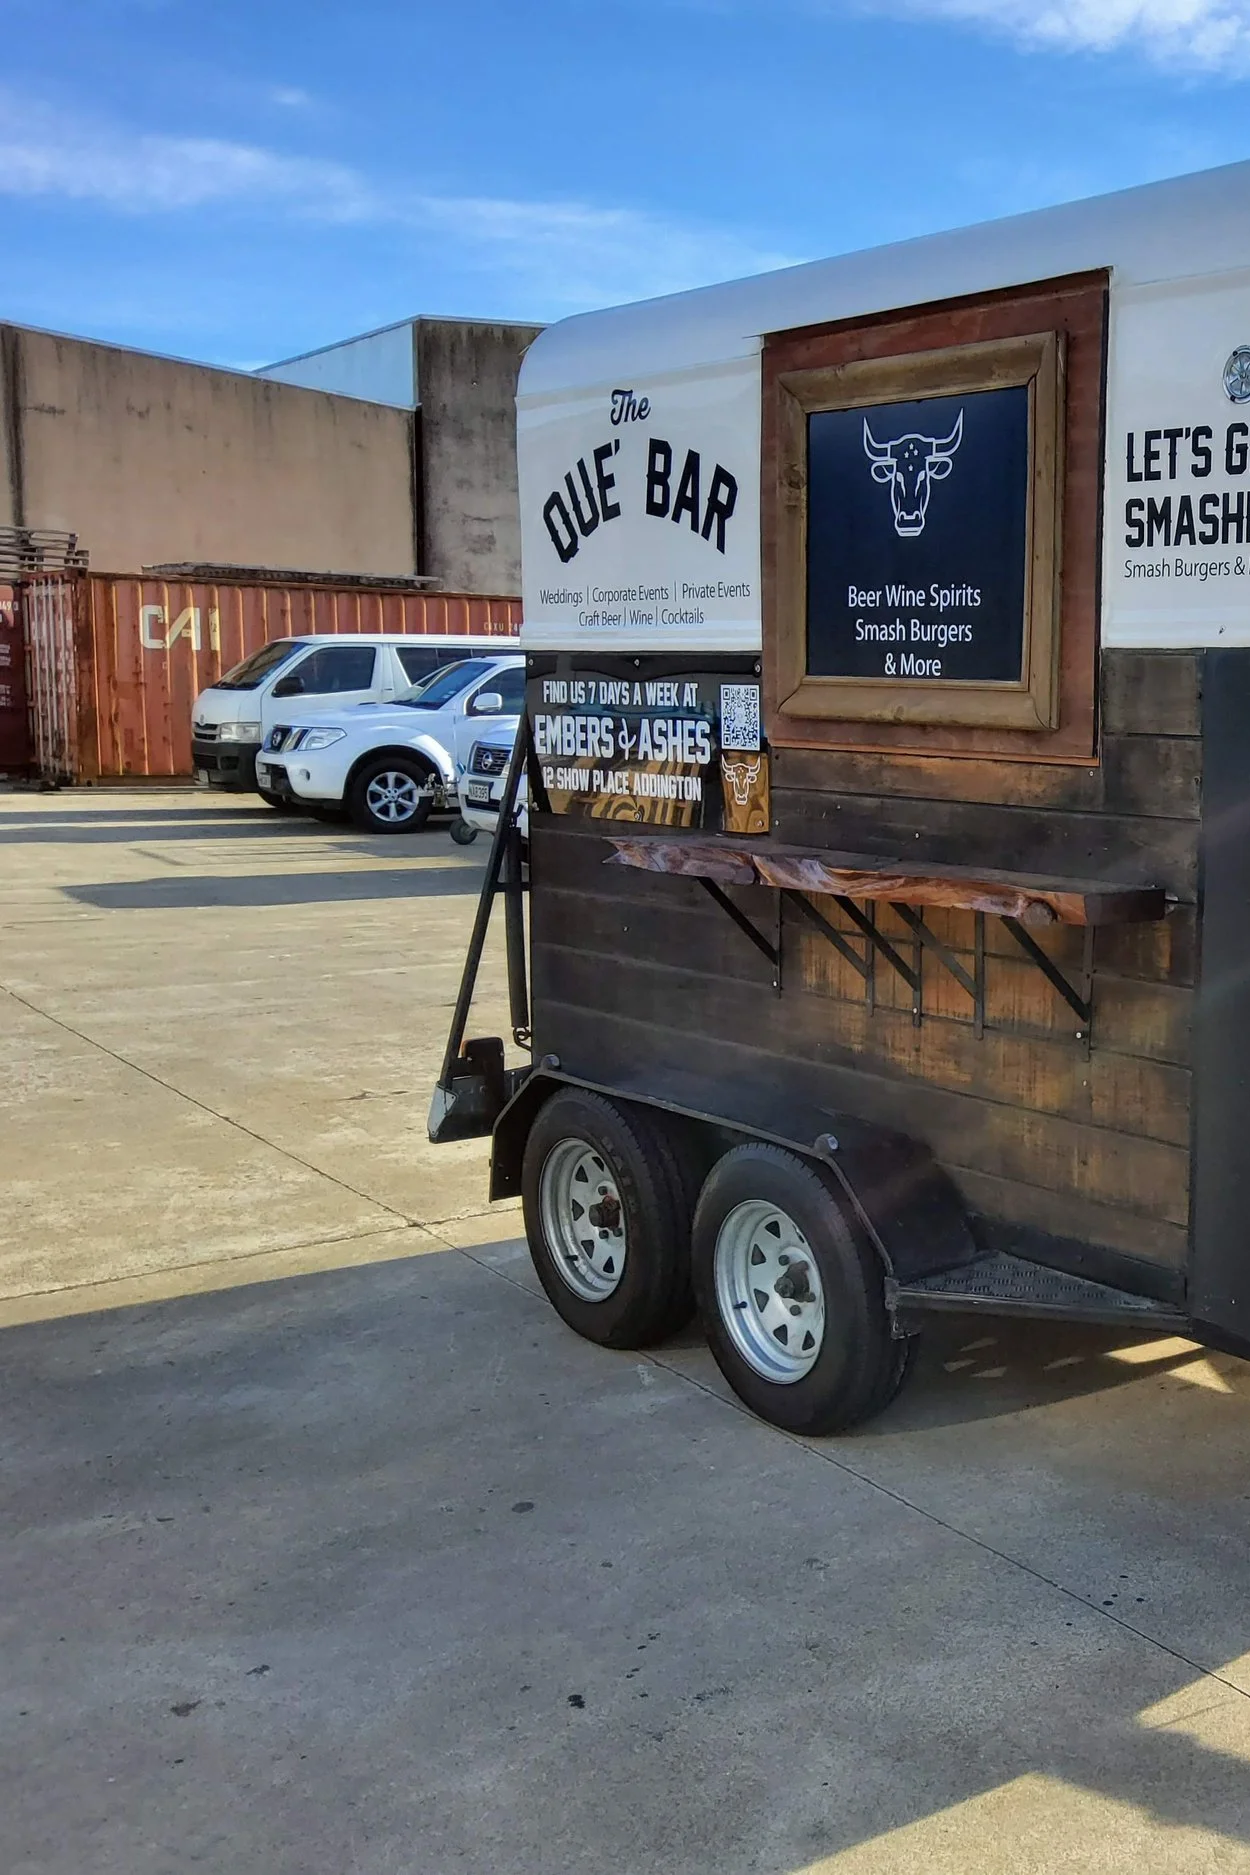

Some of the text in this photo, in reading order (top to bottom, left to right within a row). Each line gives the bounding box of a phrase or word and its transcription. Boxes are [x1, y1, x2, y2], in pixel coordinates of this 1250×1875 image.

[610, 388, 651, 425] The
[1126, 425, 1213, 483] LET'S
[646, 437, 738, 555] BAR
[1124, 557, 1170, 579] Smash
[1174, 557, 1230, 582] Burgers
[1233, 556, 1246, 576] &
[539, 581, 751, 607] Weddings Corporate Events Private Events
[848, 583, 982, 612] Beer Wine Spirits
[578, 607, 705, 627] Craft Beer Wine Cocktails
[855, 617, 973, 648] Smash Burgers
[884, 652, 942, 676] & More
[543, 680, 699, 708] FIND US 7 DAYS A WEEK AT
[534, 714, 615, 759] EMBERS
[638, 718, 711, 765] ASHES
[542, 766, 702, 802] 12 SHOW PLACE ADDINGTON
